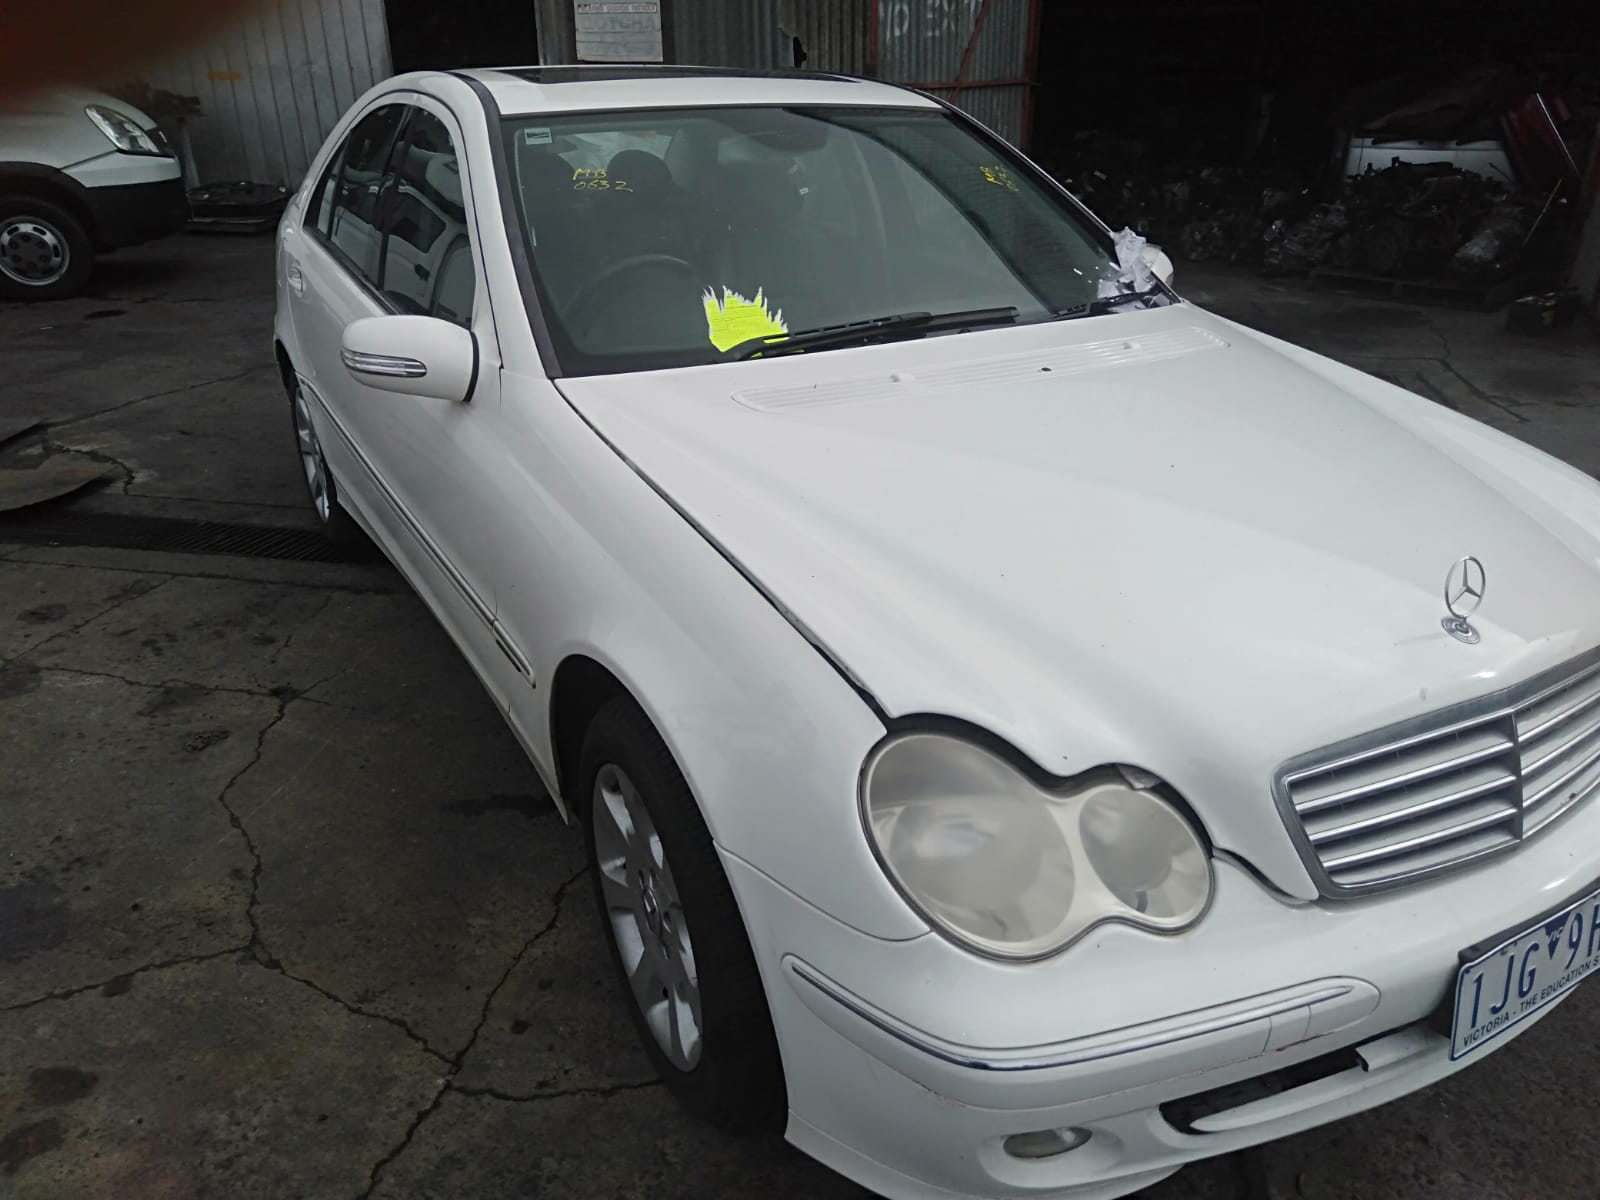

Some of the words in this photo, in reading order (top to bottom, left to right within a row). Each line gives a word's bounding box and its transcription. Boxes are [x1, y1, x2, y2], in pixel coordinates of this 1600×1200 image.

[926, 0, 984, 37] EXT
[573, 168, 607, 181] MB
[1463, 1011, 1510, 1047] VICTORIA
[1520, 992, 1538, 1012] THE
[1540, 960, 1591, 1001] EDUCATION
[1470, 941, 1540, 1029] 1JG
